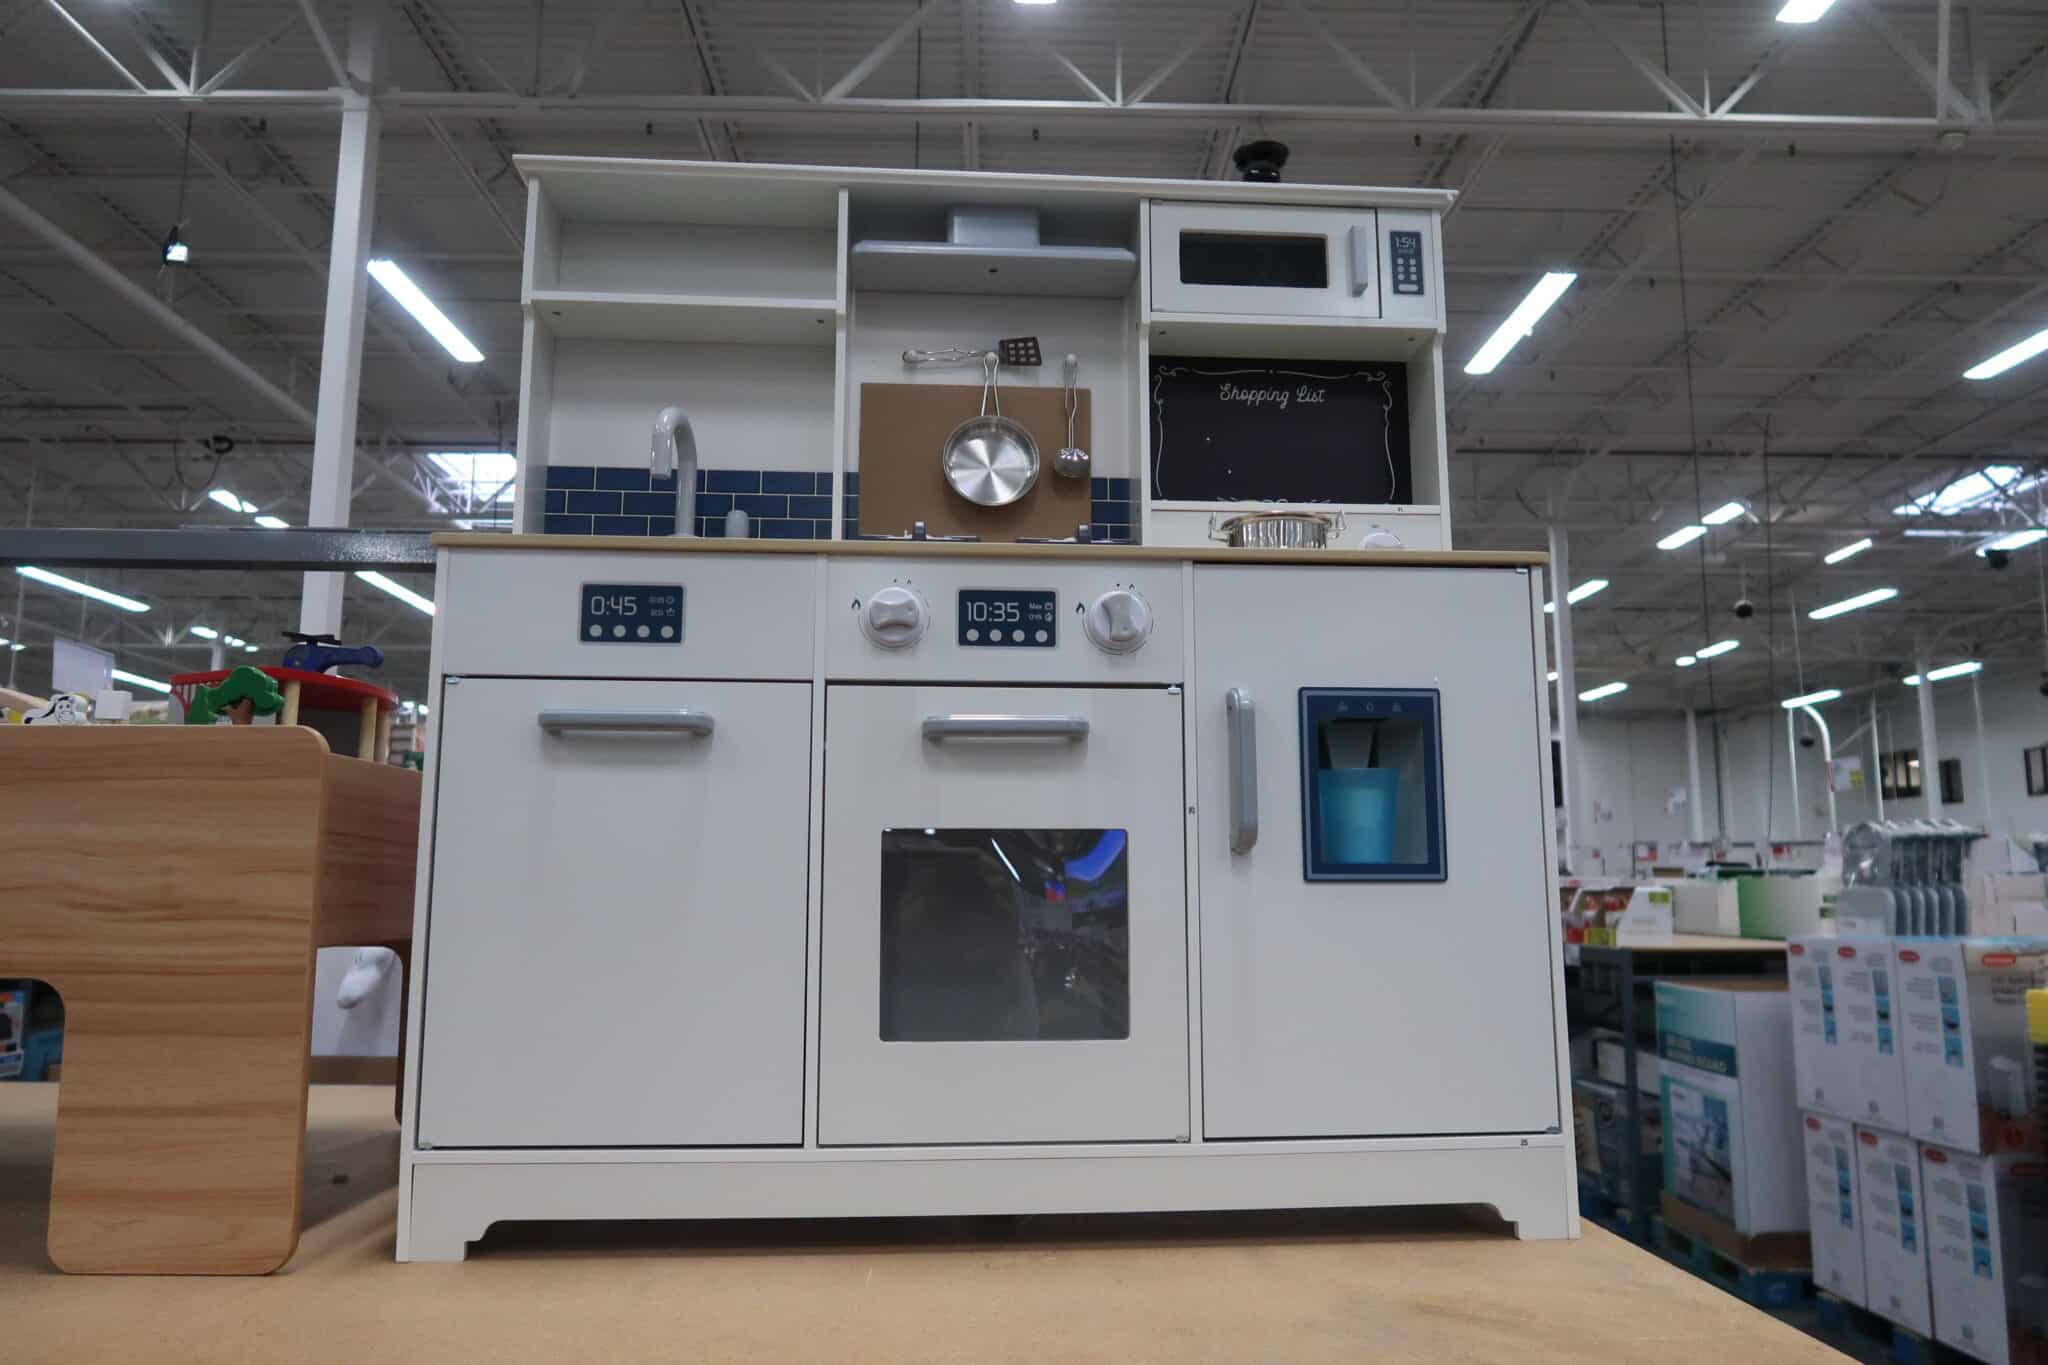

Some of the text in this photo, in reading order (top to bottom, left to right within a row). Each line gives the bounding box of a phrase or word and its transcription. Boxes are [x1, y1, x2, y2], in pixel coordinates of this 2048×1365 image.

[1219, 382, 1327, 409] Shopping List
[591, 595, 638, 616] 0:45
[966, 601, 1020, 622] 10:35
